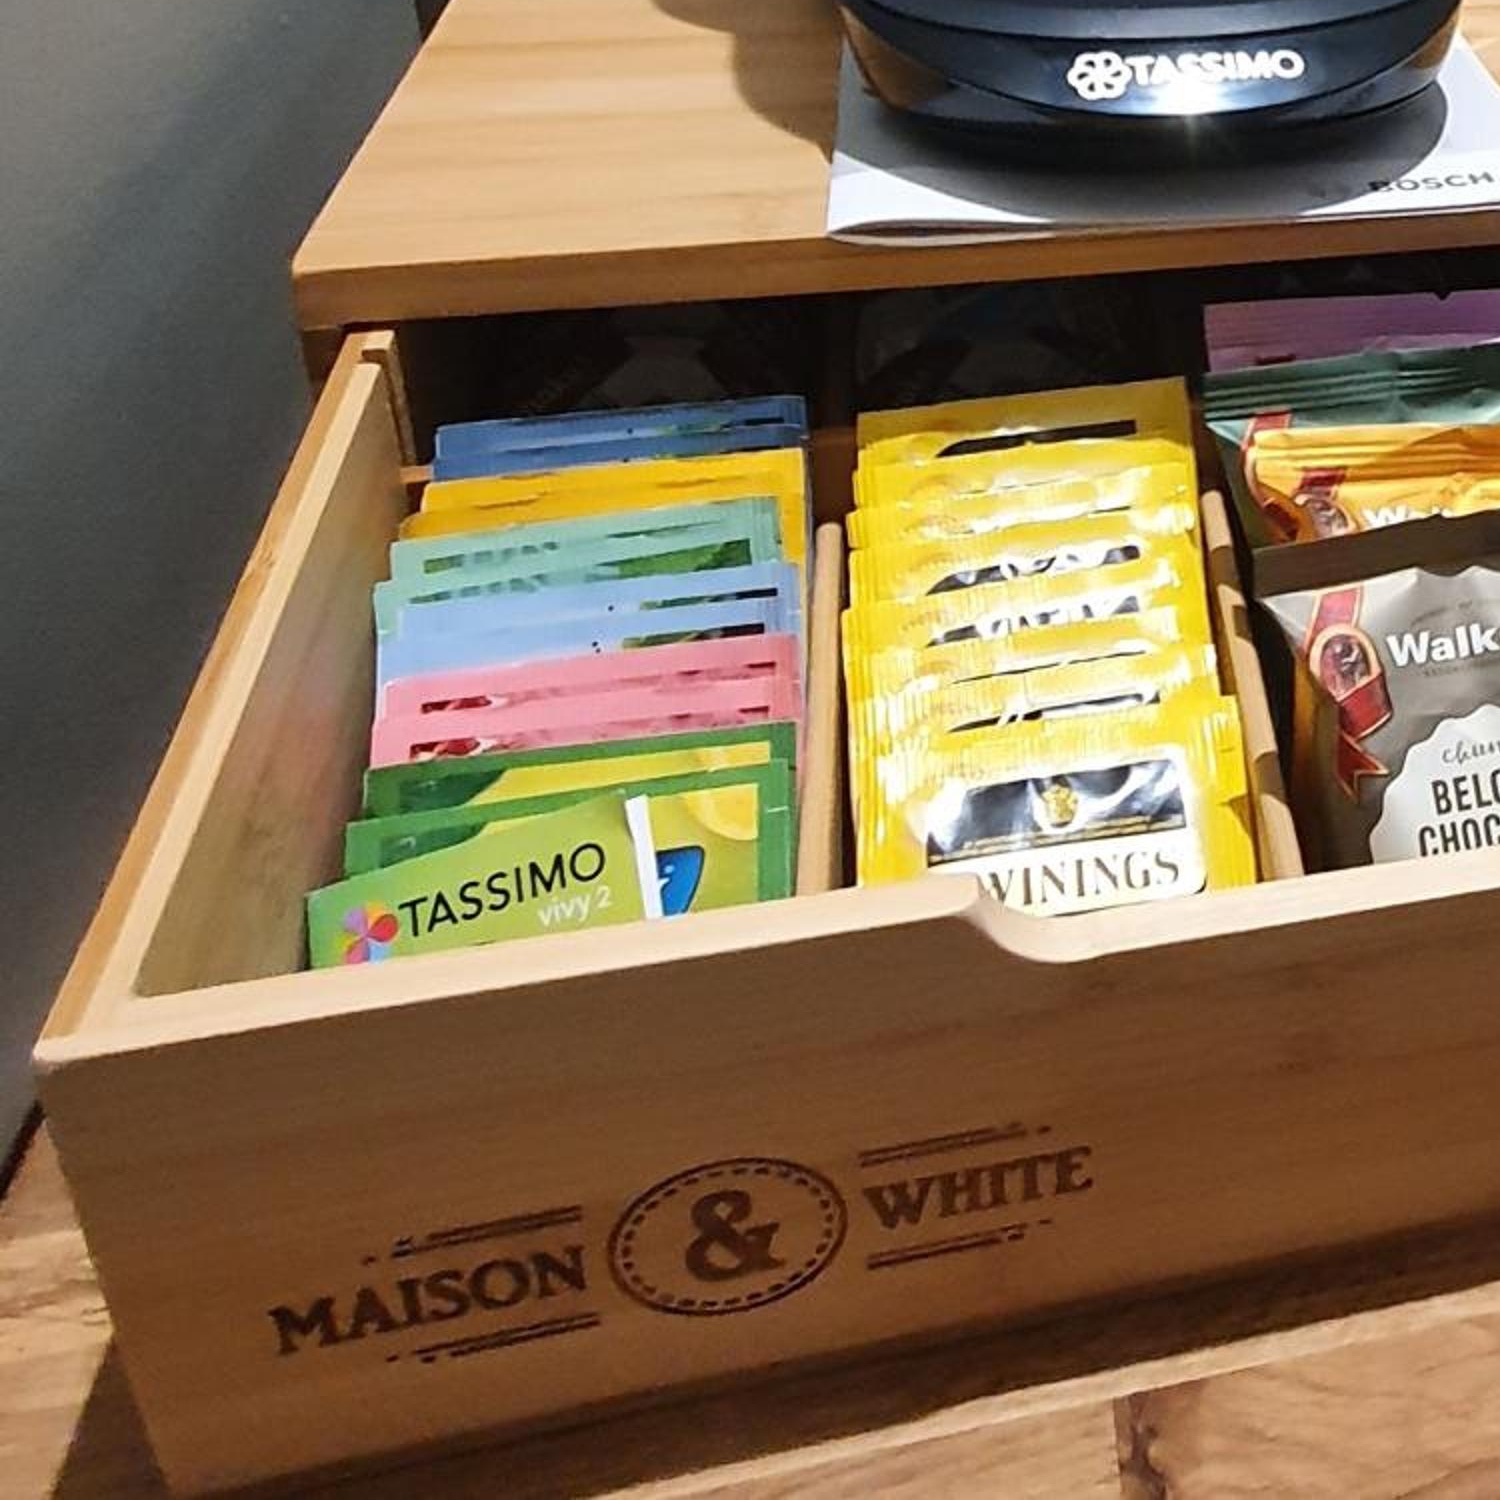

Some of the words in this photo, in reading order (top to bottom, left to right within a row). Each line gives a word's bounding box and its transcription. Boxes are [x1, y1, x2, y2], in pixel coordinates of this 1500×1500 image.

[1124, 49, 1305, 86] TASSIMO
[1367, 171, 1495, 192] BOSCH
[400, 843, 606, 938] TASSIMO
[977, 850, 1180, 906] WININGS
[538, 892, 590, 927] vivy
[597, 885, 612, 909] 2
[268, 1245, 586, 1355] MAISON
[684, 1189, 785, 1282] &
[863, 1146, 1093, 1230] WHITE
